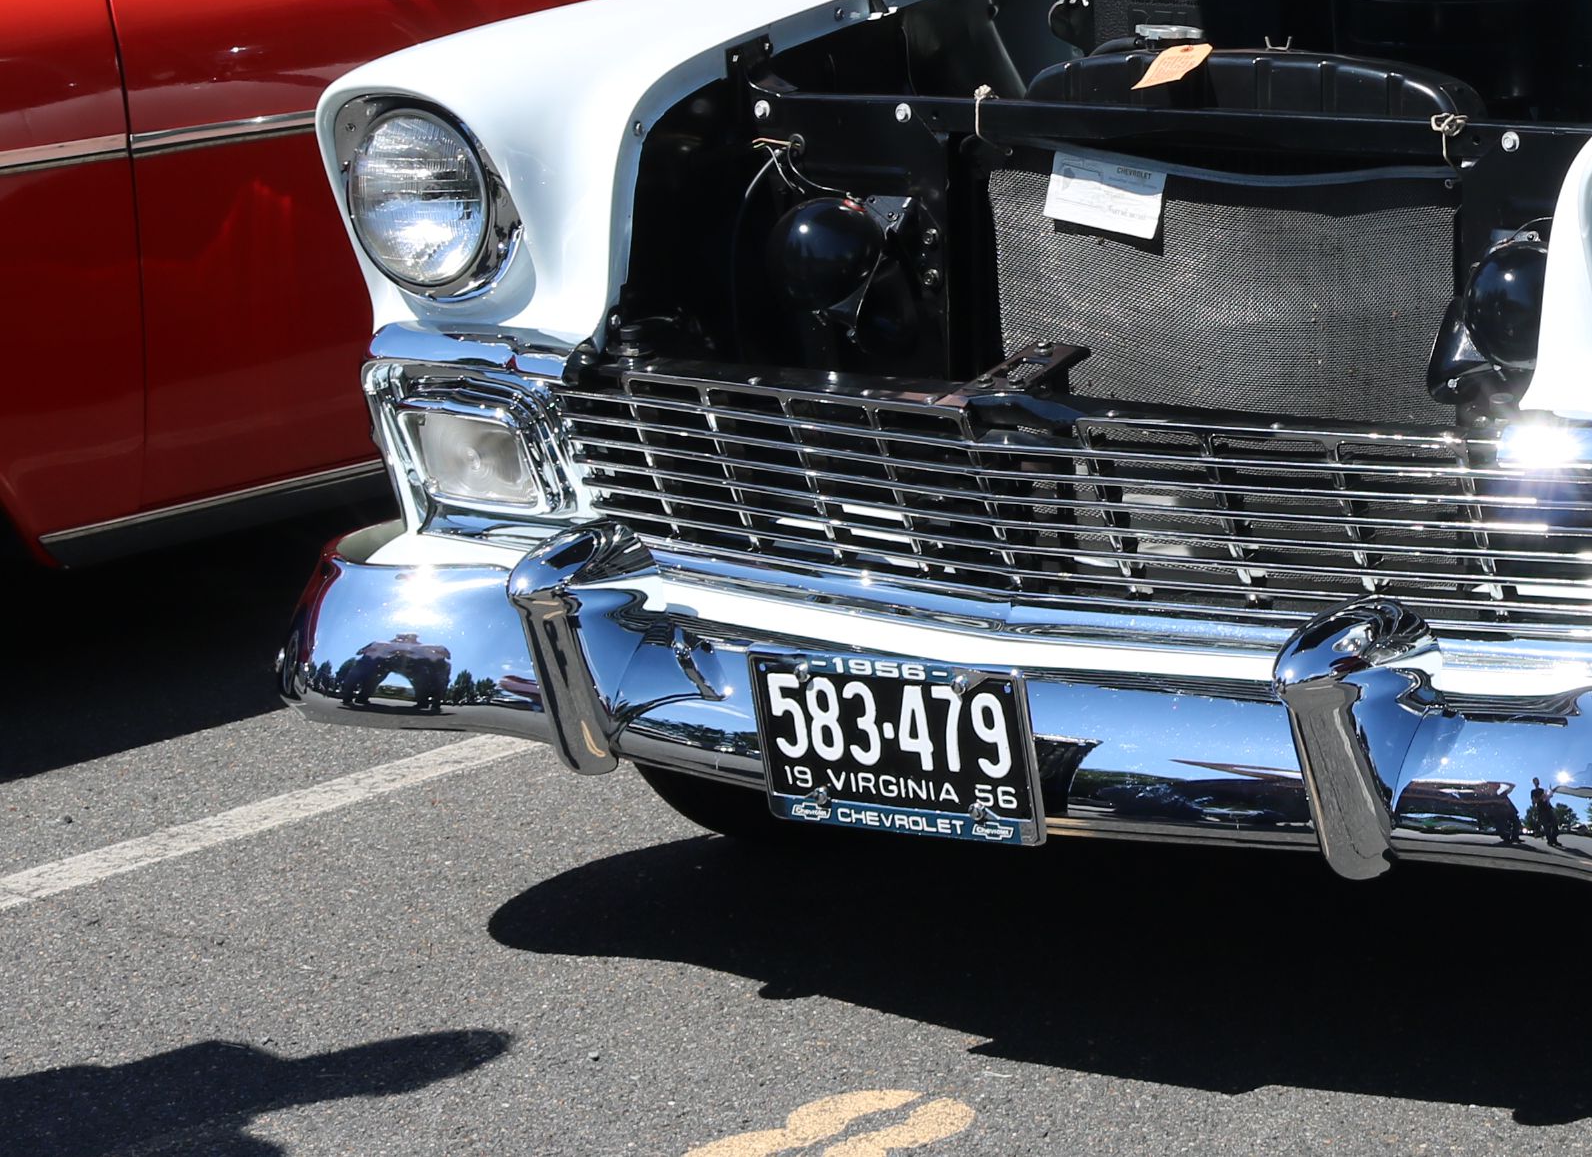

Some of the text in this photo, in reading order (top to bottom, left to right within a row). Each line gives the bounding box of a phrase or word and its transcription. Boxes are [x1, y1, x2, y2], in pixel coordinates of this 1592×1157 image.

[1116, 166, 1152, 180] CHEVROLET
[784, 765, 1018, 810] 19 VIRGINIA 56
[836, 807, 964, 835] CHEVROLET
